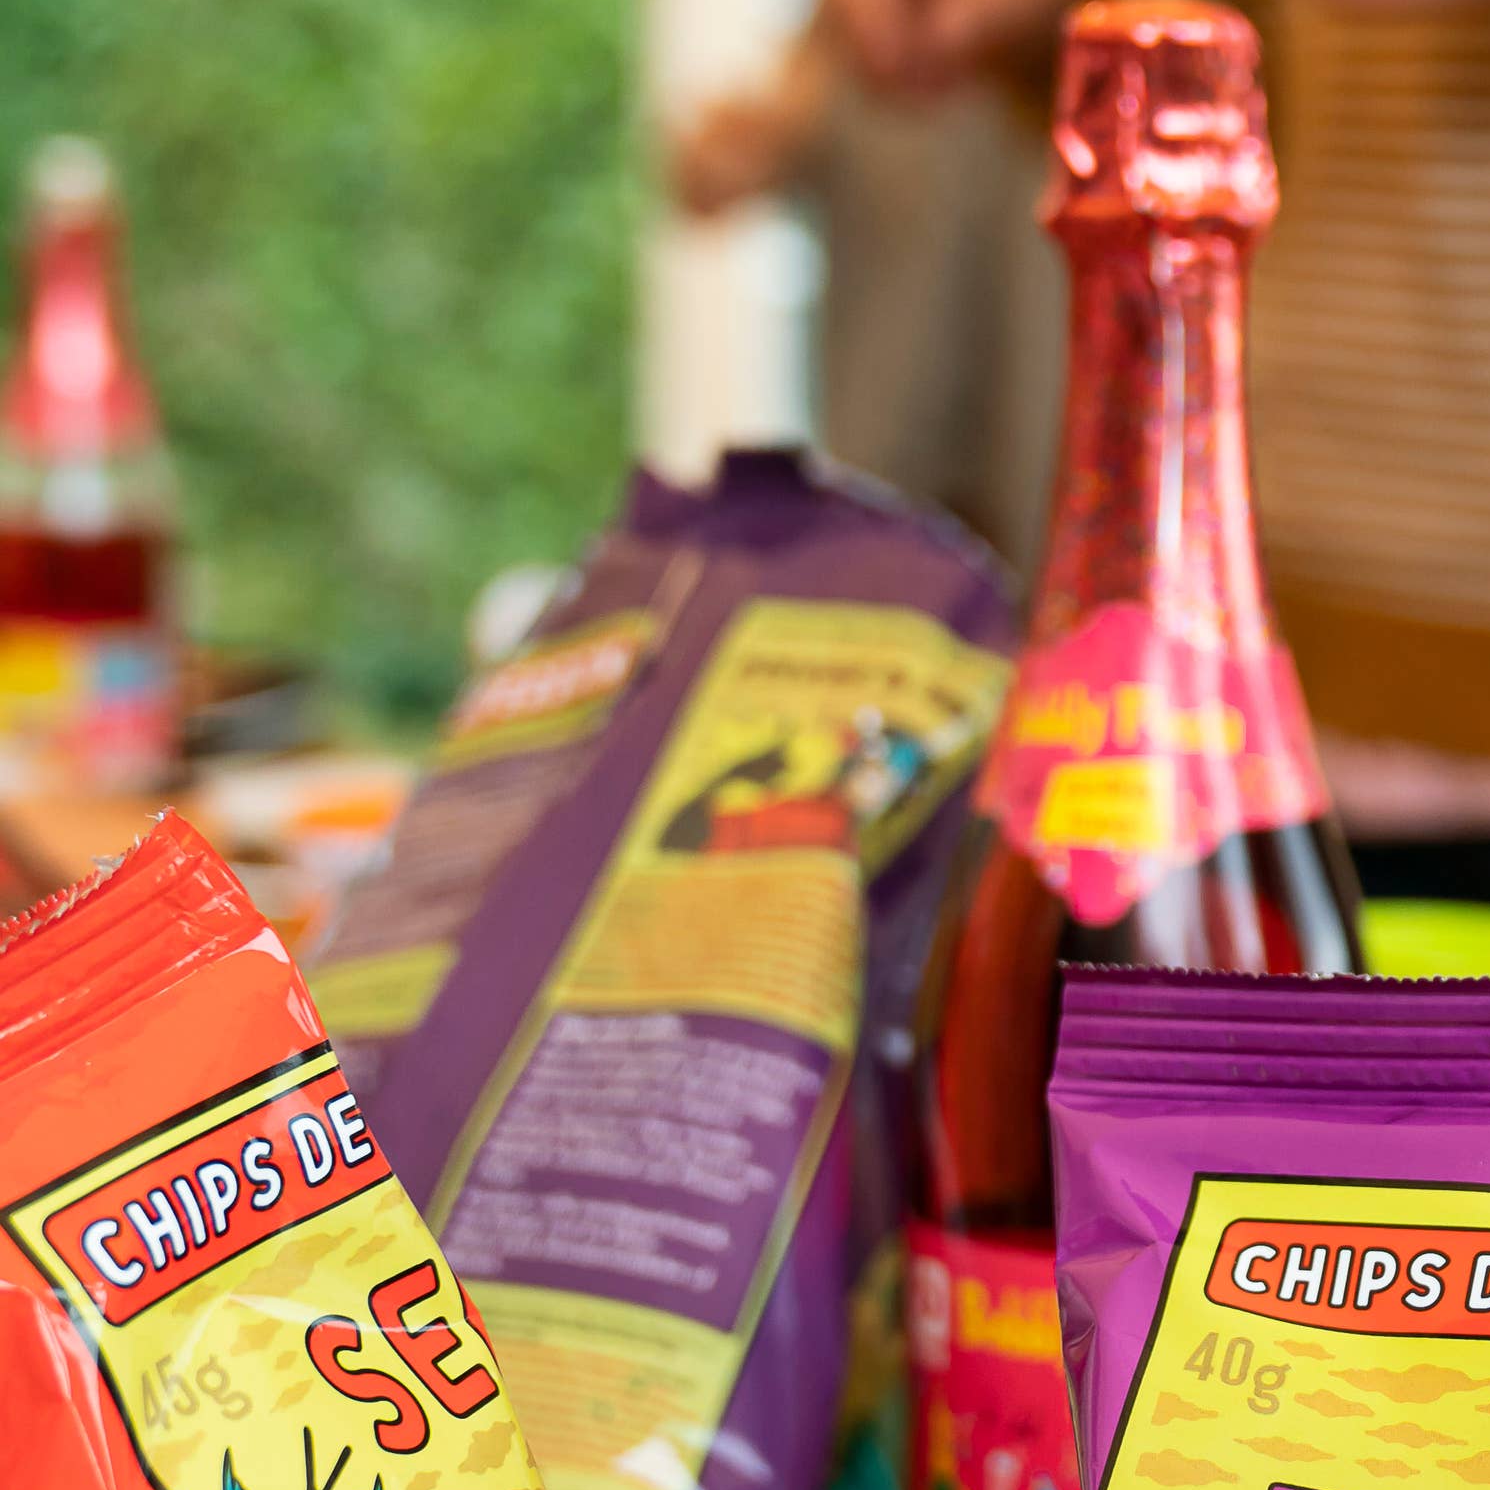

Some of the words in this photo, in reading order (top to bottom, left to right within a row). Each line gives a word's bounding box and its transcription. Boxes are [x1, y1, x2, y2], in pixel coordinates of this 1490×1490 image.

[80, 1137, 285, 1288] CHIPS
[288, 1091, 376, 1188] DE
[1230, 1240, 1449, 1312] CHIPS
[141, 1352, 254, 1431] 45g
[304, 1259, 502, 1455] SE
[1183, 1331, 1292, 1415] 40g
